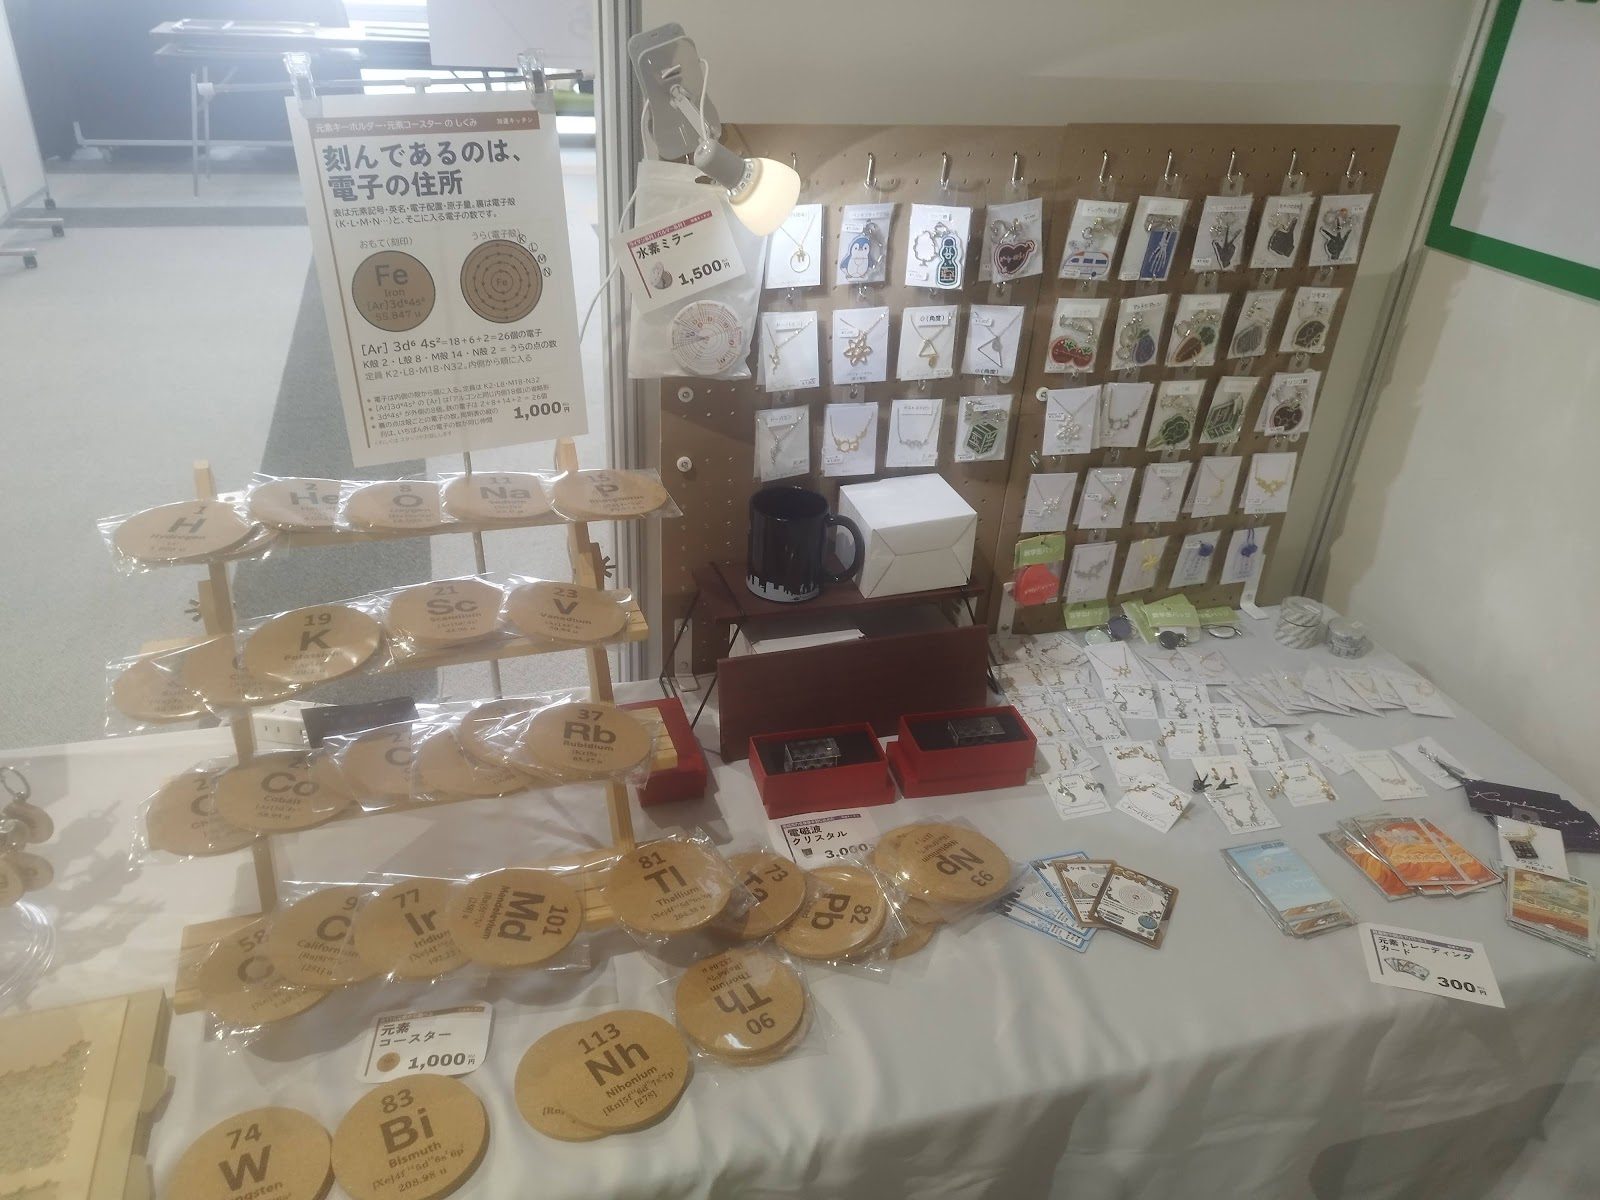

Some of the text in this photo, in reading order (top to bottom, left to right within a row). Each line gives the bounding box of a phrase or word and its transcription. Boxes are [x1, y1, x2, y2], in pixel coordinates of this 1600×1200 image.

[322, 139, 521, 172] 刻んであるのは、
[328, 170, 463, 202] 電子の住所
[636, 230, 694, 260] 水素ミラー
[374, 264, 408, 287] Fe
[678, 259, 722, 286] 1,500
[361, 342, 388, 356] [Ar]
[514, 401, 561, 421] 1,000
[290, 492, 339, 505] He
[393, 494, 423, 507] O
[480, 486, 531, 499] Na
[168, 517, 207, 533] H
[552, 588, 579, 598] 23
[426, 599, 478, 615] Sc
[553, 599, 579, 615] V
[303, 613, 331, 626] 19
[300, 629, 332, 651] K
[578, 709, 603, 720] 37
[563, 720, 617, 743] Rb
[261, 772, 319, 796] Co
[788, 825, 822, 837] 電磁波
[792, 831, 847, 846] クリスタル
[638, 851, 666, 869] 81
[936, 848, 984, 875] Np
[644, 865, 687, 894] Tl
[765, 864, 789, 883] 73
[971, 870, 994, 887] 93
[393, 888, 419, 908] 77
[498, 891, 546, 941] Md
[542, 904, 569, 936] 101
[811, 893, 851, 929] Pb
[850, 904, 871, 924] 82
[405, 909, 436, 936] Ir
[1379, 937, 1472, 960] 元素トレーディング
[1381, 945, 1410, 955] カード
[1437, 976, 1476, 993] 300
[714, 982, 773, 1014] Th
[381, 1022, 410, 1036] 元素
[746, 1012, 775, 1035] 90
[379, 1031, 451, 1047] コースター
[578, 1023, 621, 1055] 113
[408, 1053, 466, 1070] 1,000
[584, 1043, 650, 1086] Nh
[605, 1066, 657, 1098] Nihonium
[381, 1088, 414, 1114] 83
[226, 1123, 262, 1150] 74
[380, 1107, 434, 1154] Bi
[389, 1141, 441, 1168] Bismuth
[218, 1144, 272, 1191] W
